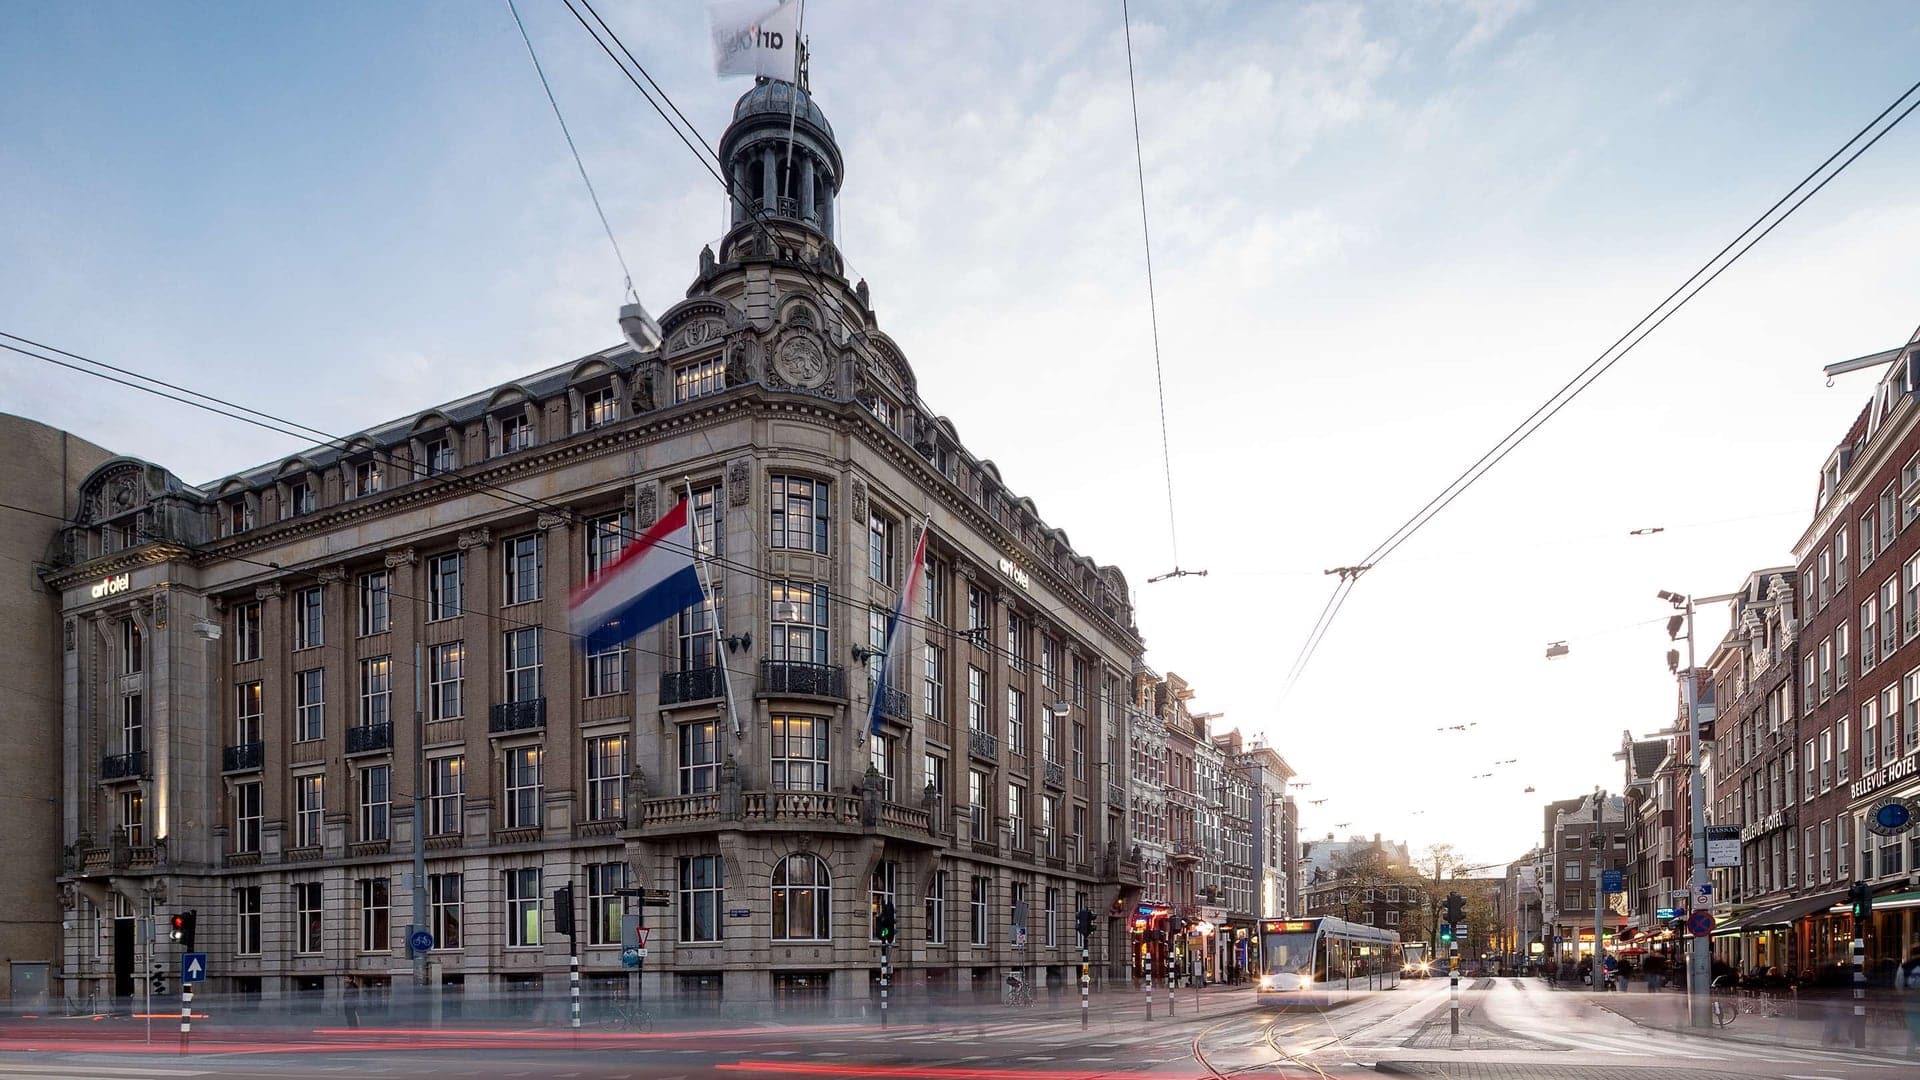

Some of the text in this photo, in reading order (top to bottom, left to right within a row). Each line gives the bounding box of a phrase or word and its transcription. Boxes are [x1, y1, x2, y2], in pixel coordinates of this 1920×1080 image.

[1850, 755, 1917, 799] BELLEVUE HOTEL
[1741, 810, 1782, 843] BELLEVUE HOTEL
